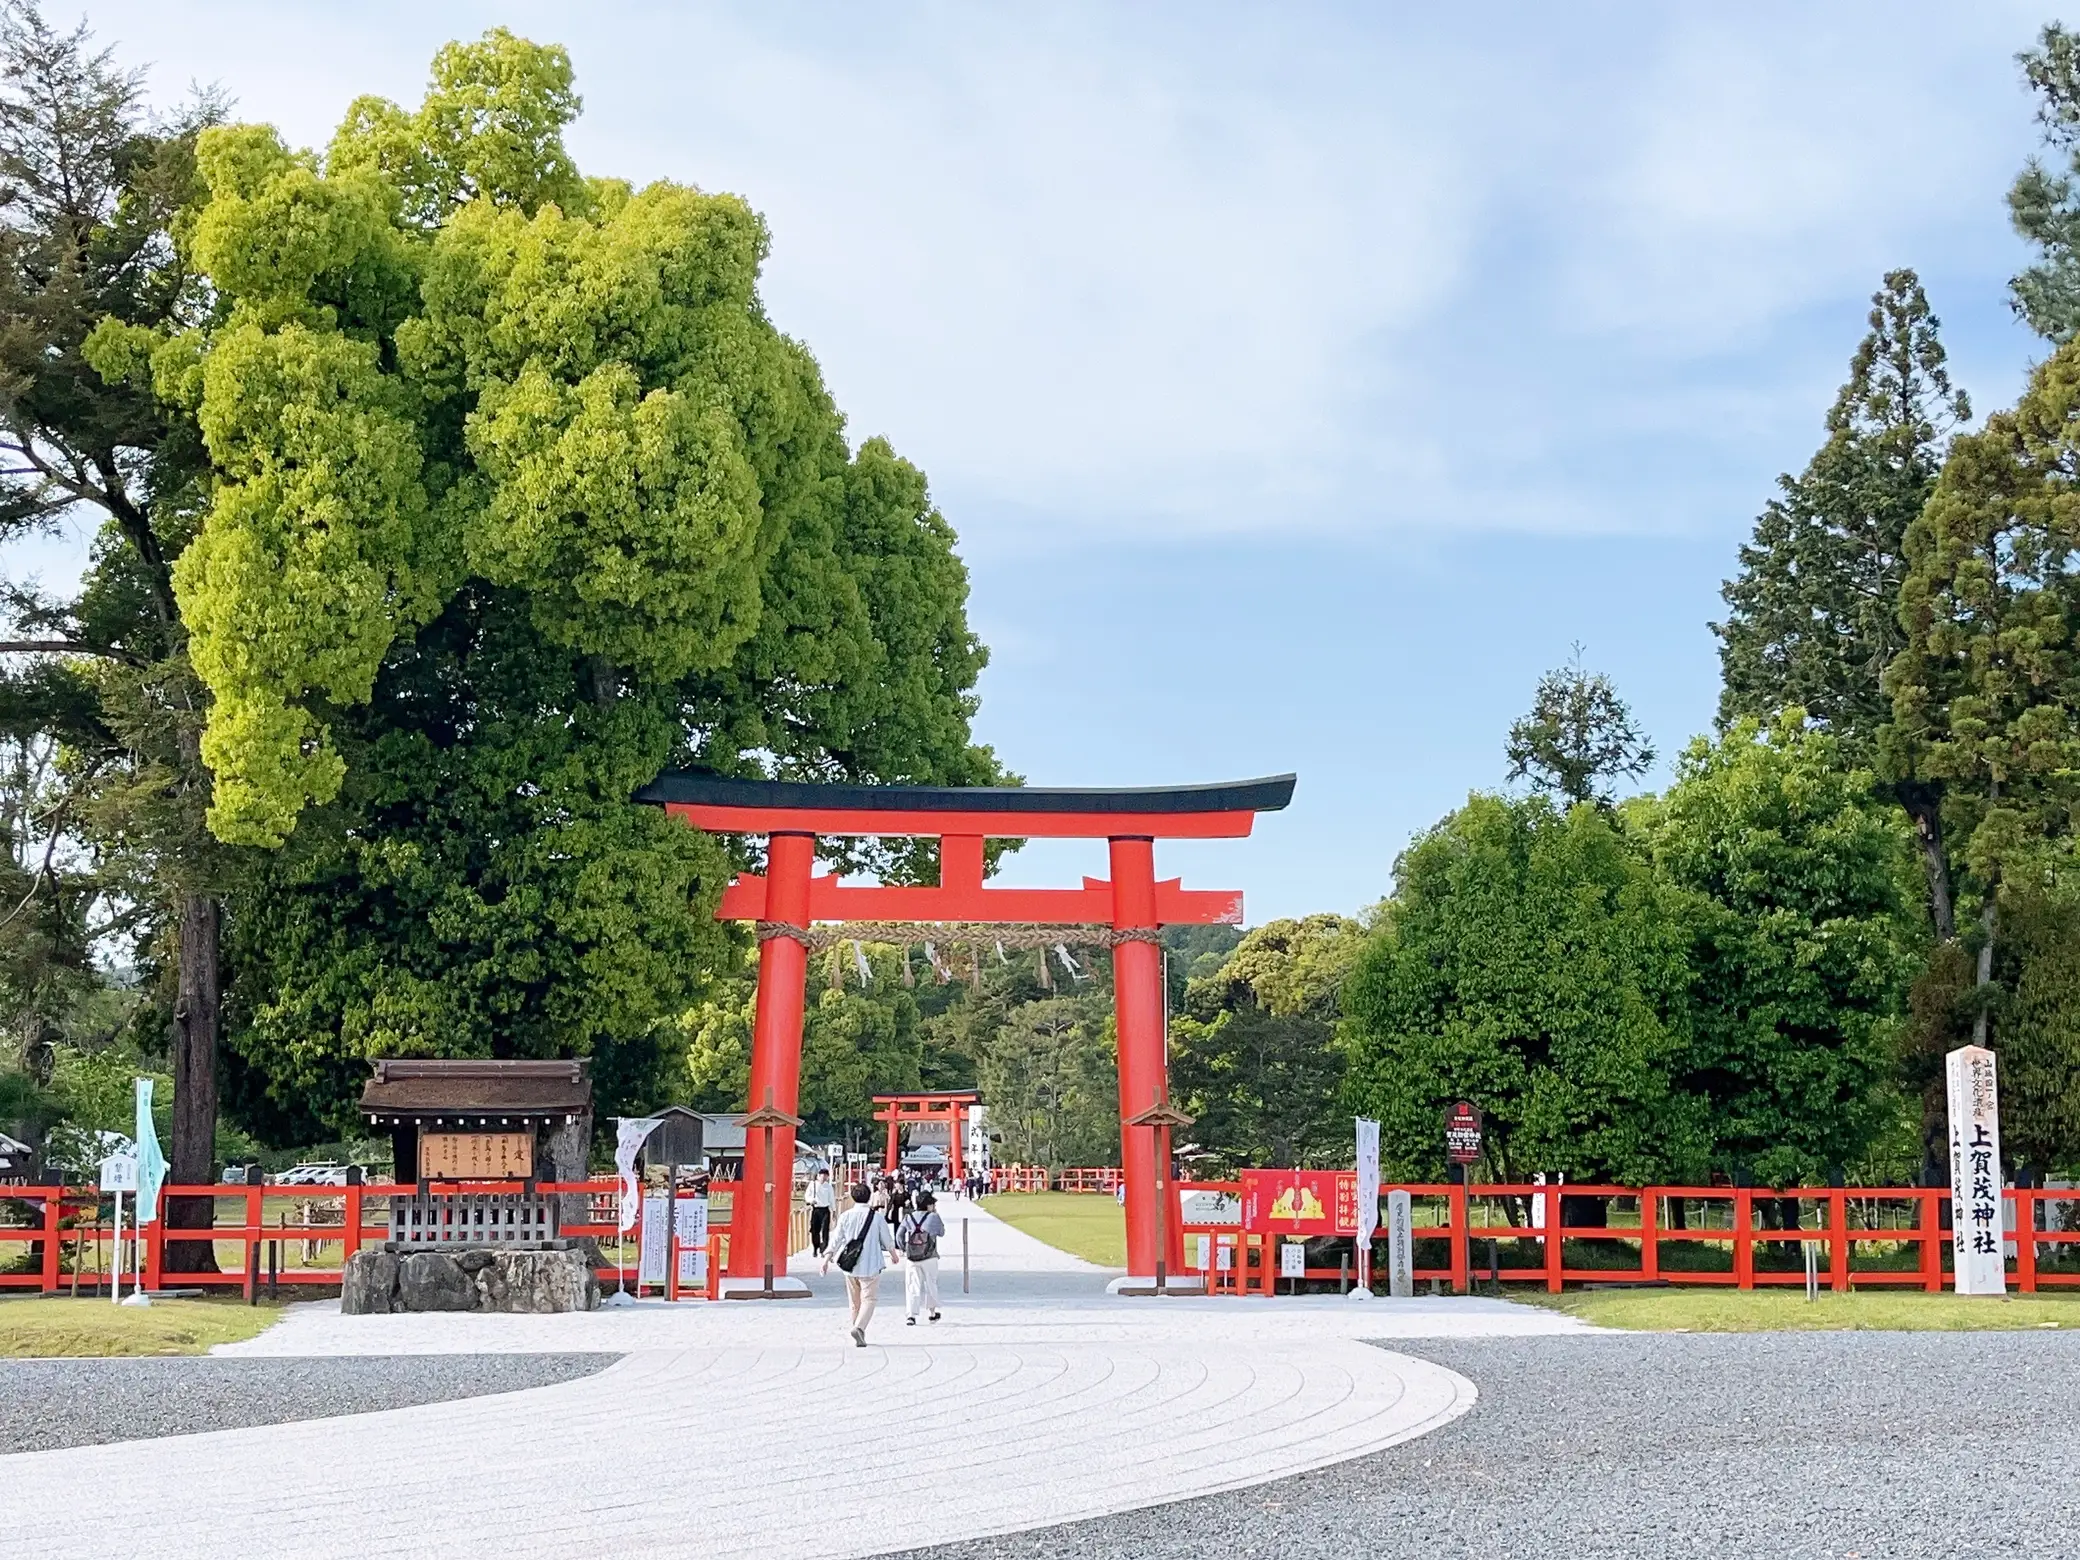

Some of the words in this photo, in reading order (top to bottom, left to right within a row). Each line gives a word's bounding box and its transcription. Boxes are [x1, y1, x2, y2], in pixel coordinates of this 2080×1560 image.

[1338, 1179, 1350, 1228] 特別拝観
[1968, 1124, 1998, 1255] 上賀茂神社
